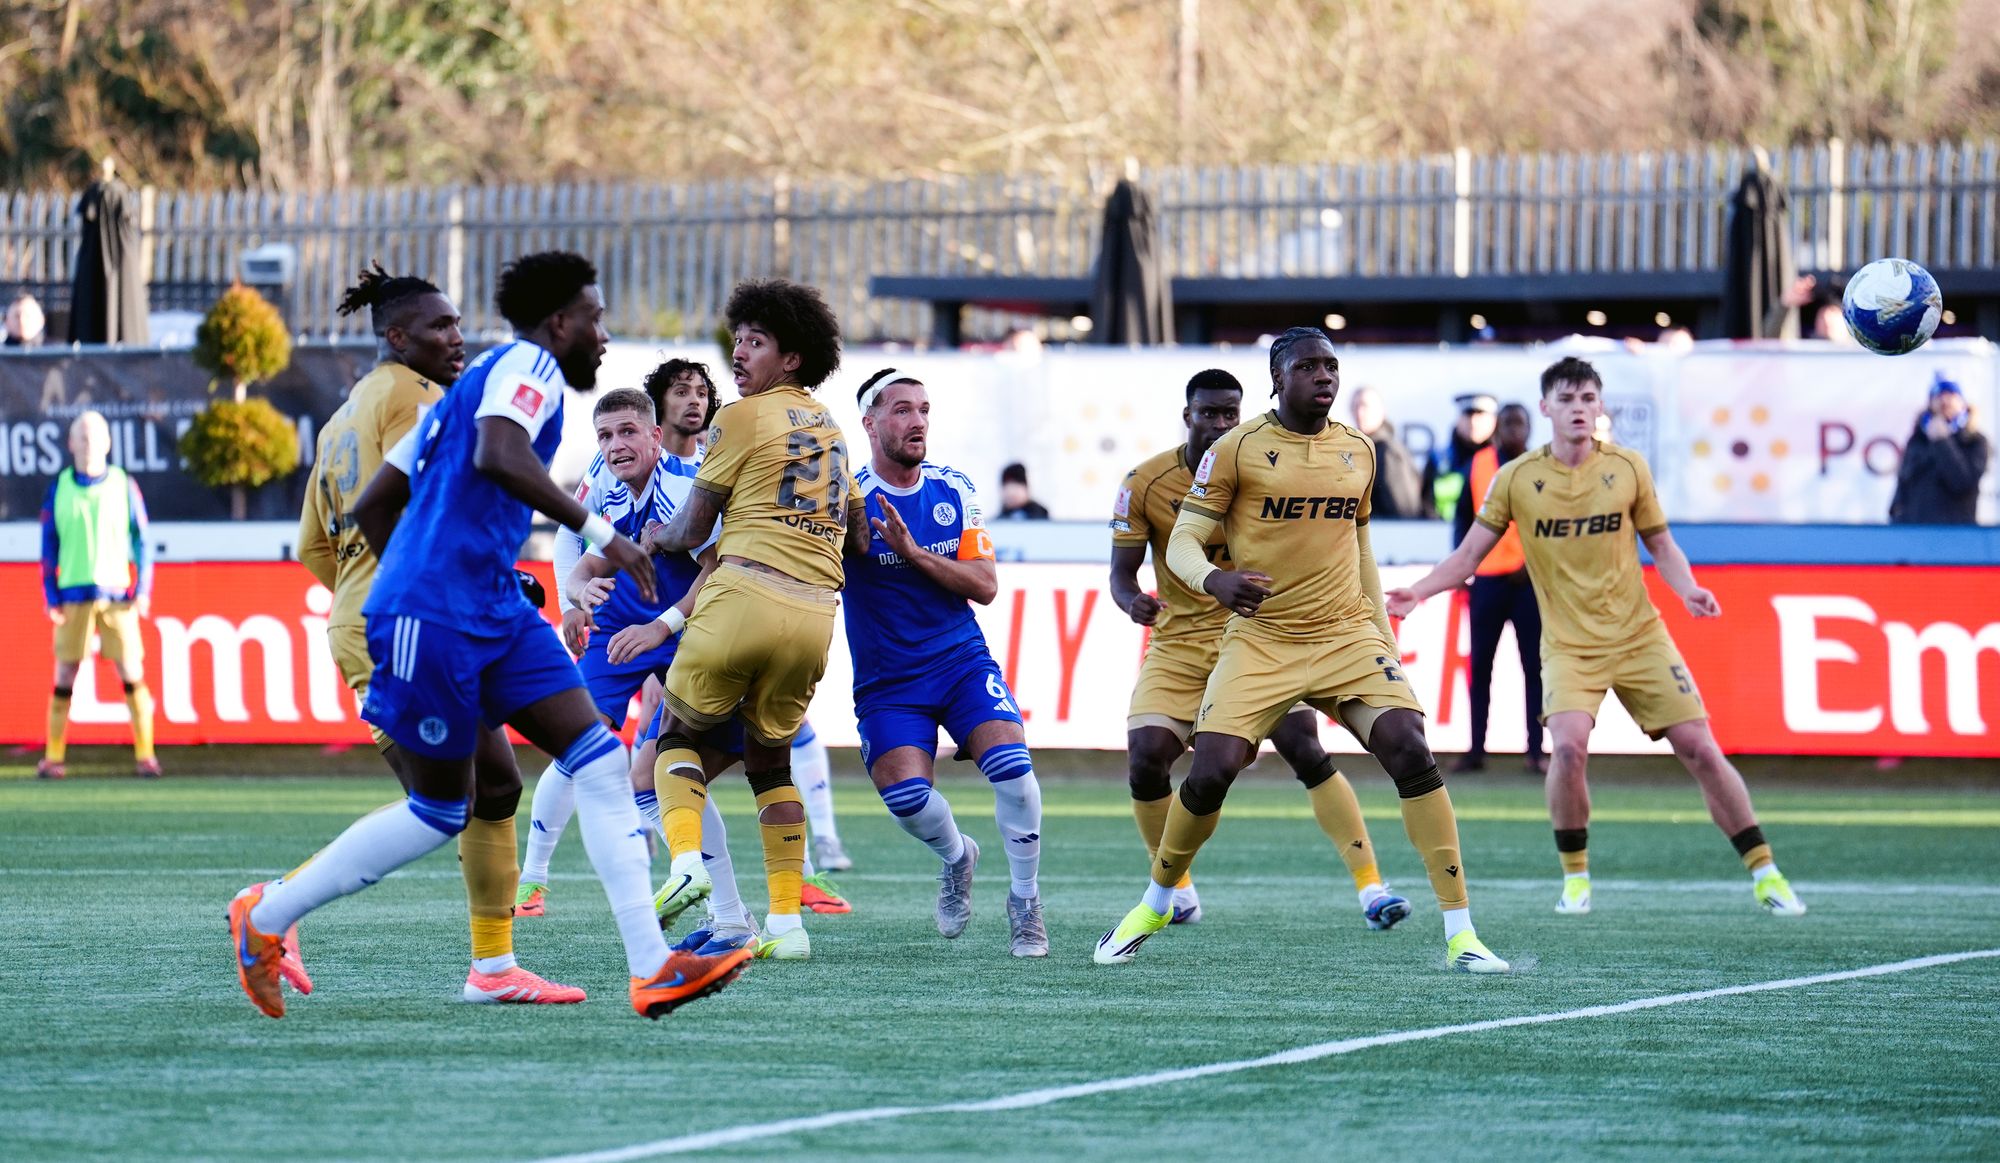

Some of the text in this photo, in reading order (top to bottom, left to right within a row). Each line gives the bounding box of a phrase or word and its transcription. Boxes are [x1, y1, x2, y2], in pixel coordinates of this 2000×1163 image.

[1260, 496, 1360, 520] NET88
[1534, 512, 1623, 539] NET88
[976, 531, 994, 556] C
[985, 673, 1007, 699] 6
[1670, 664, 1692, 694] 5
